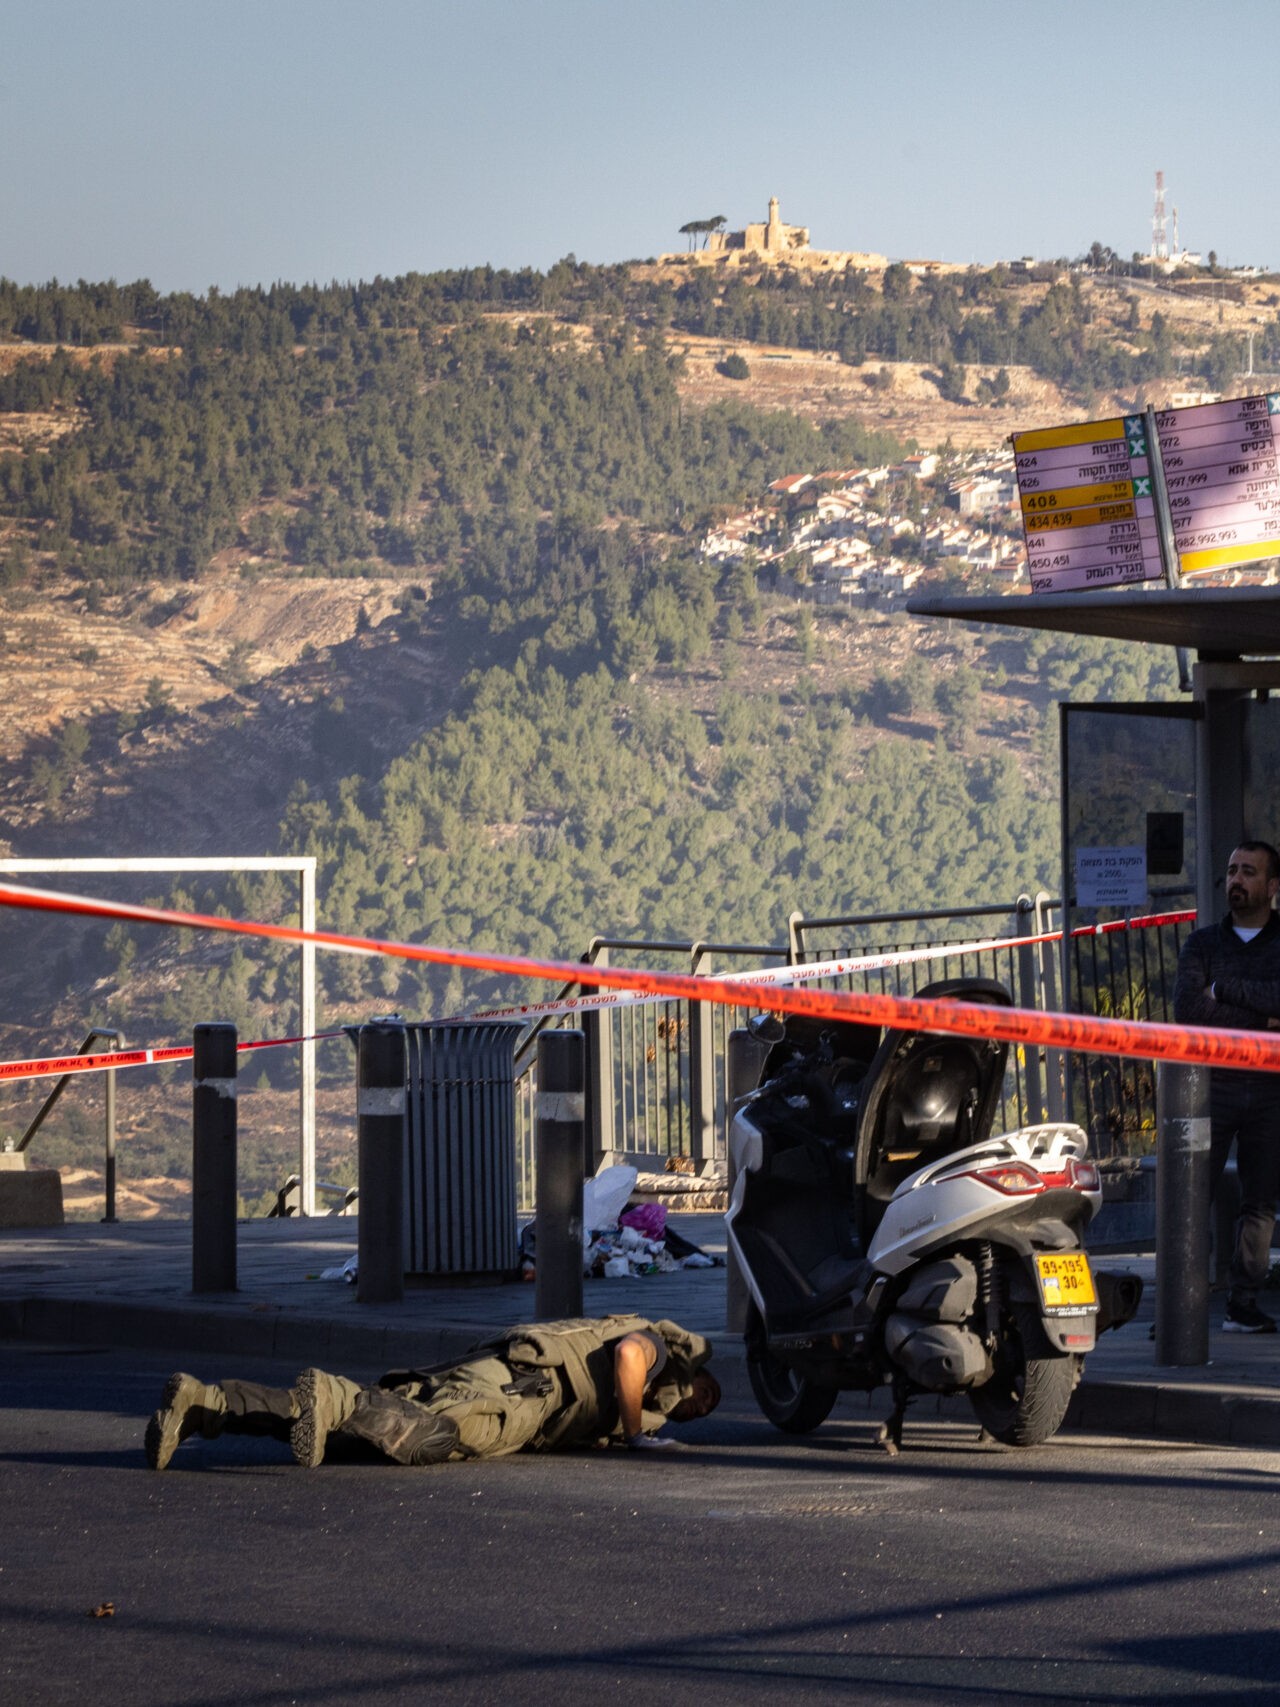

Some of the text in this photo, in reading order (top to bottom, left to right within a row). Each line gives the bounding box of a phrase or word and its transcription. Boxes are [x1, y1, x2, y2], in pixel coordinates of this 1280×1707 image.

[1241, 400, 1267, 412] חיפה
[1158, 416, 1177, 428] 972
[1245, 419, 1269, 432] חיפה
[1092, 442, 1126, 456] רחובות
[1161, 437, 1180, 448] 972
[1241, 439, 1273, 453] רכסים
[1018, 457, 1038, 468] 424
[1164, 457, 1184, 468] 996
[1252, 458, 1276, 472] קרית
[1020, 478, 1040, 488] 426
[1168, 473, 1208, 487] 997,999
[1246, 478, 1278, 493] דימונה
[1027, 495, 1057, 509] 408
[1255, 498, 1280, 511] אלעד
[1029, 513, 1073, 529] 434,439
[1174, 517, 1192, 529] 577
[1110, 522, 1138, 534] גדרה
[1028, 538, 1045, 548] 441
[1177, 530, 1238, 549] 982,992,993
[1107, 542, 1140, 555] אשדוד
[1031, 555, 1070, 569] 450,451
[1116, 562, 1143, 575] מגדל
[1086, 566, 1114, 580] העמק
[1033, 578, 1053, 589] 952
[1063, 1275, 1078, 1289] 30
